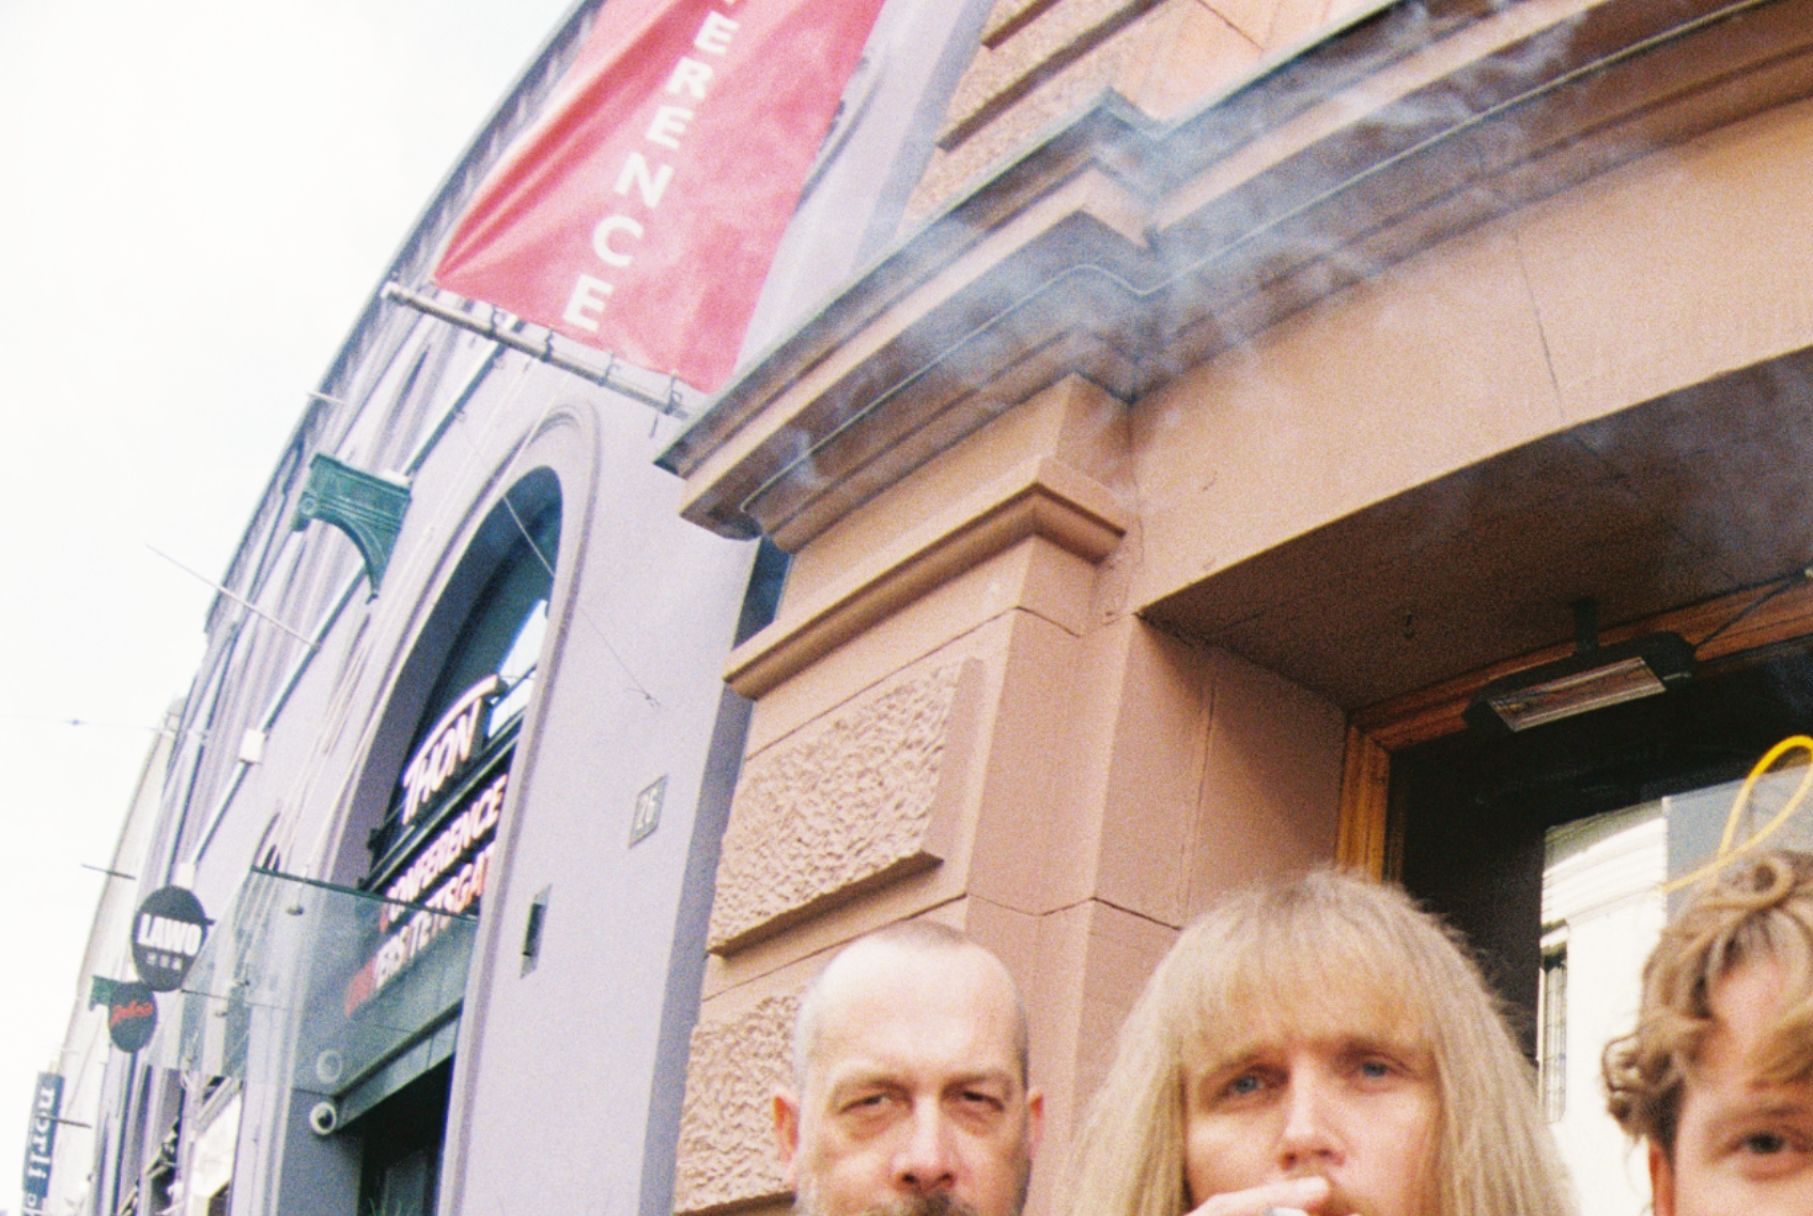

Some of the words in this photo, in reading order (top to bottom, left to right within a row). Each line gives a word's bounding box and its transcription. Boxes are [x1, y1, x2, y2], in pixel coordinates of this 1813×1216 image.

[561, 0, 740, 332] ERENCE
[402, 697, 483, 826] THON
[28, 1086, 55, 1180] norli
